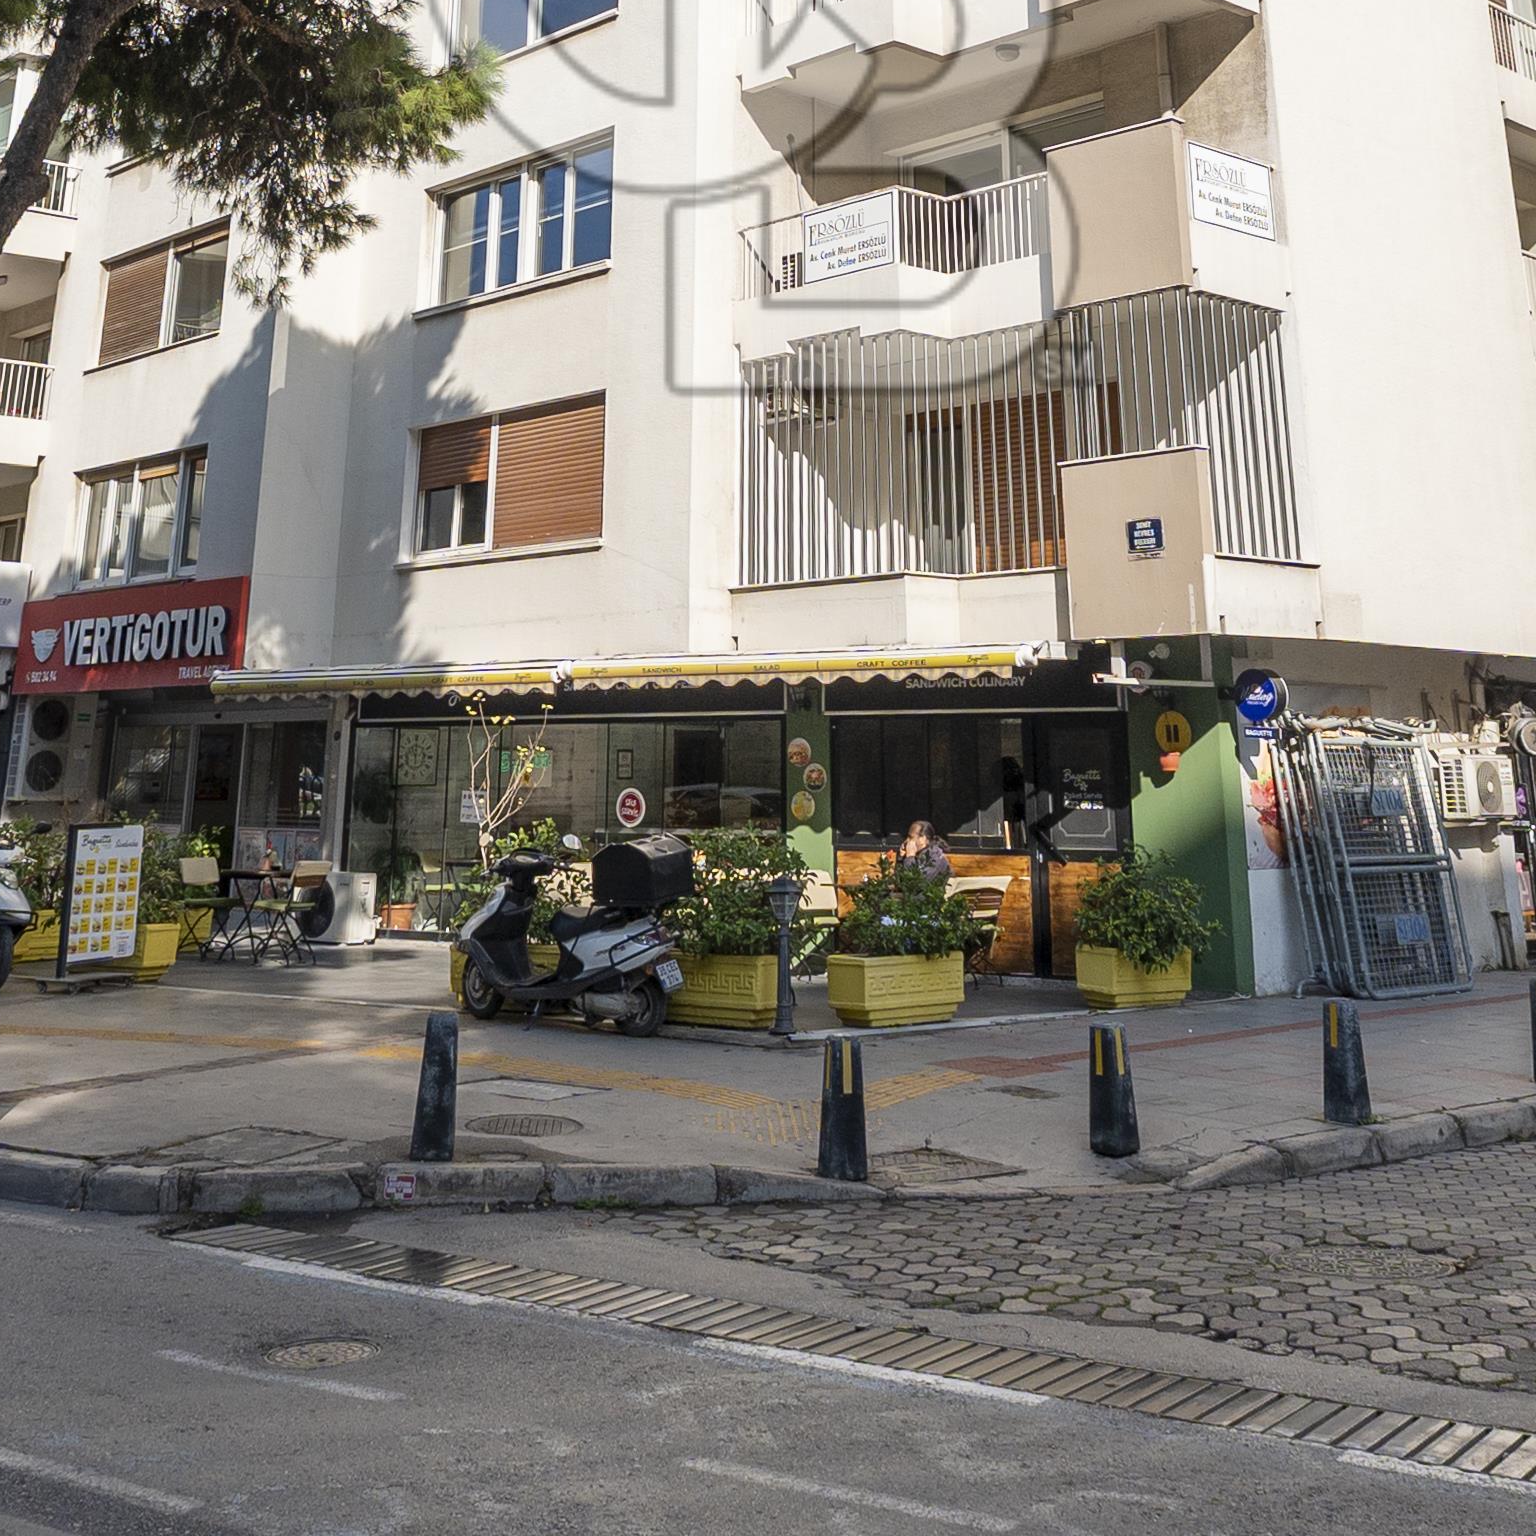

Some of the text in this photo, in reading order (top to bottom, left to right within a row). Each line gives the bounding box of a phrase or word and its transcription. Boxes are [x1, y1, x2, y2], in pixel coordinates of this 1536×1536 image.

[857, 661, 885, 669] CRAFT
[892, 659, 927, 667] COFFEE
[969, 676, 1026, 688] CULINARY
